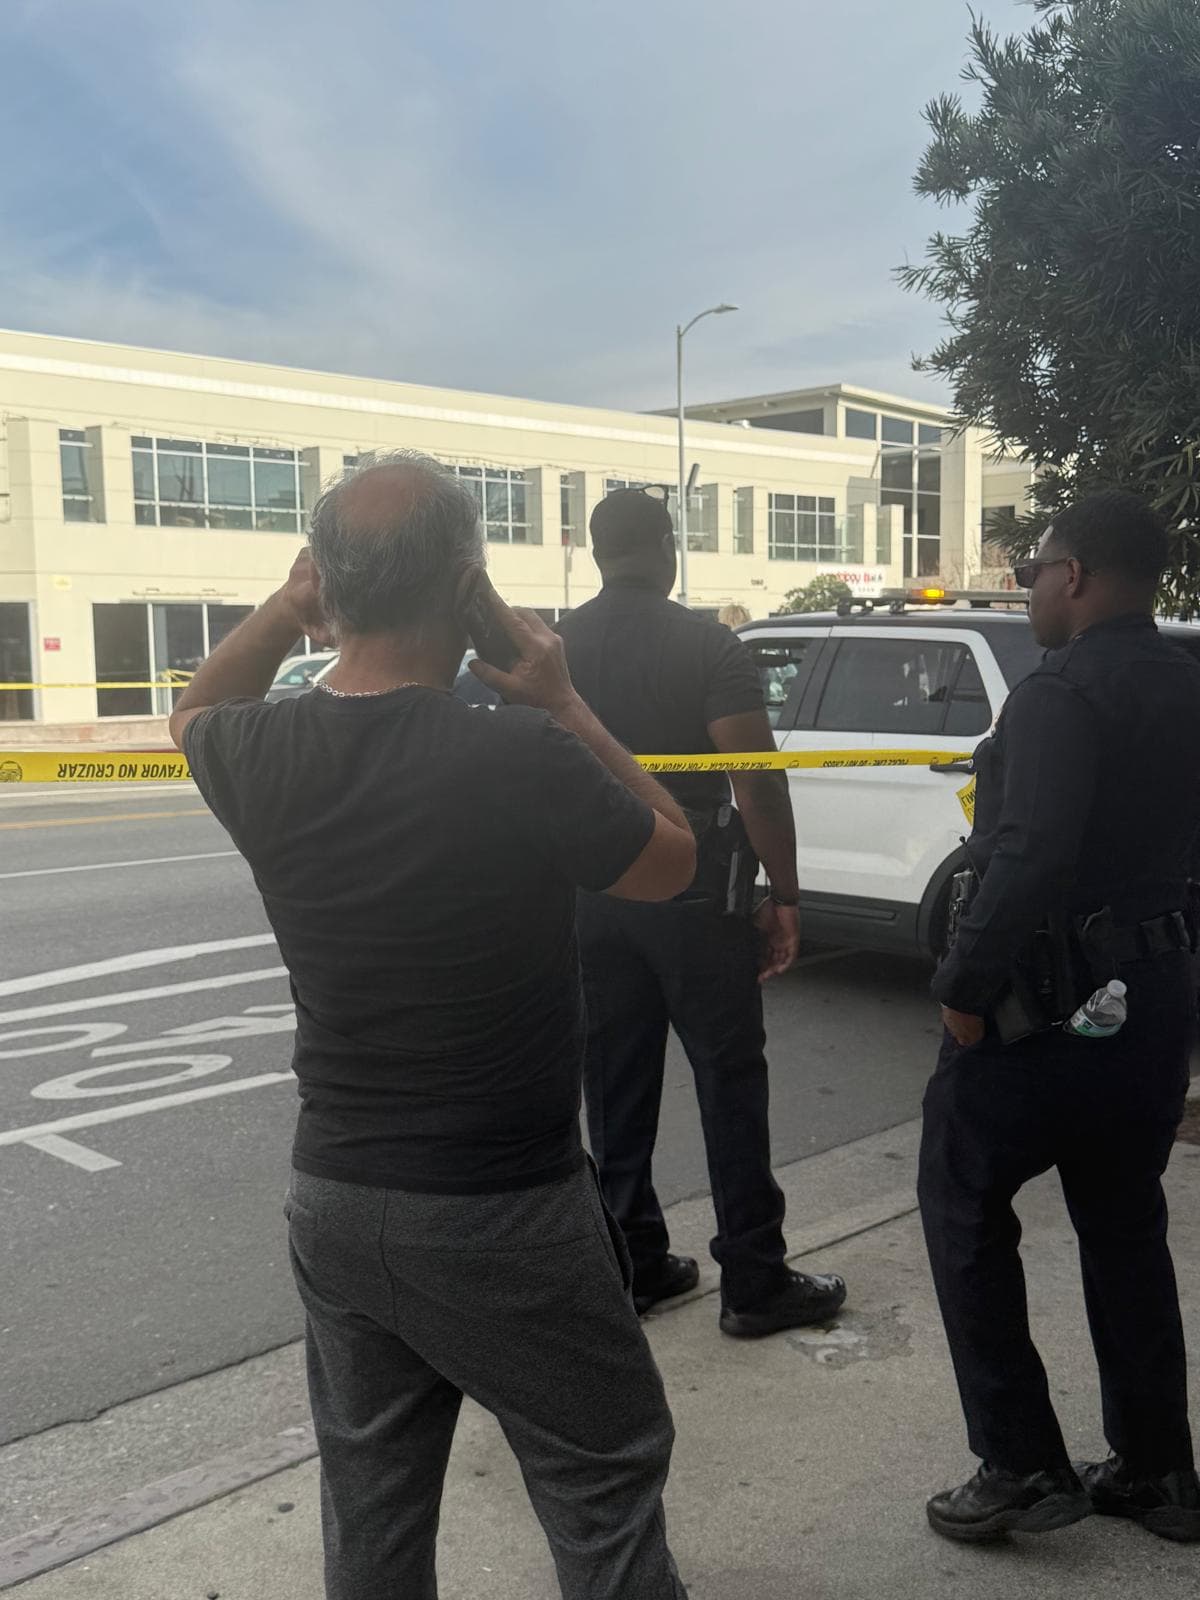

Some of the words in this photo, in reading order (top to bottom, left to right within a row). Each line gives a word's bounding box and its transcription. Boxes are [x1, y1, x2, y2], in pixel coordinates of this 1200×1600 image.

[57, 763, 115, 778] CRUZAR
[118, 764, 138, 778] NO
[142, 764, 184, 778] FAVOR
